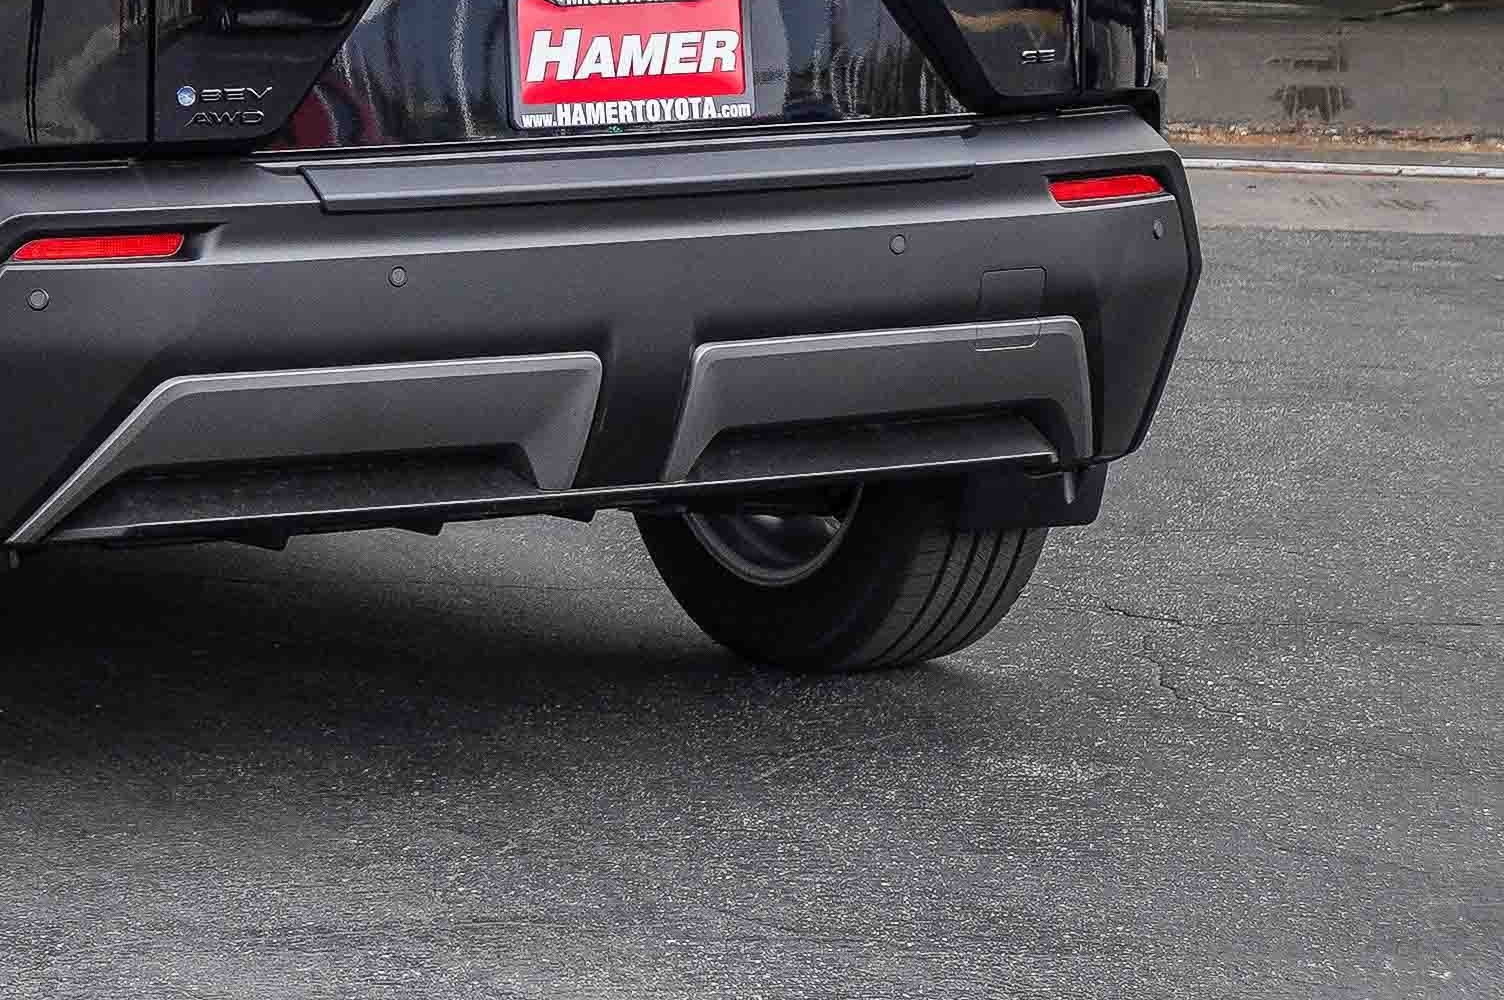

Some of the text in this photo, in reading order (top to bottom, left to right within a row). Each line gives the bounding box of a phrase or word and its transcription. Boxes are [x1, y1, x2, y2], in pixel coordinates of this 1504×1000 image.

[526, 28, 740, 83] HAMER
[200, 86, 273, 101] BEV
[184, 109, 265, 128] AWD
[521, 97, 751, 128] www.HAMERTOYOTA.com
